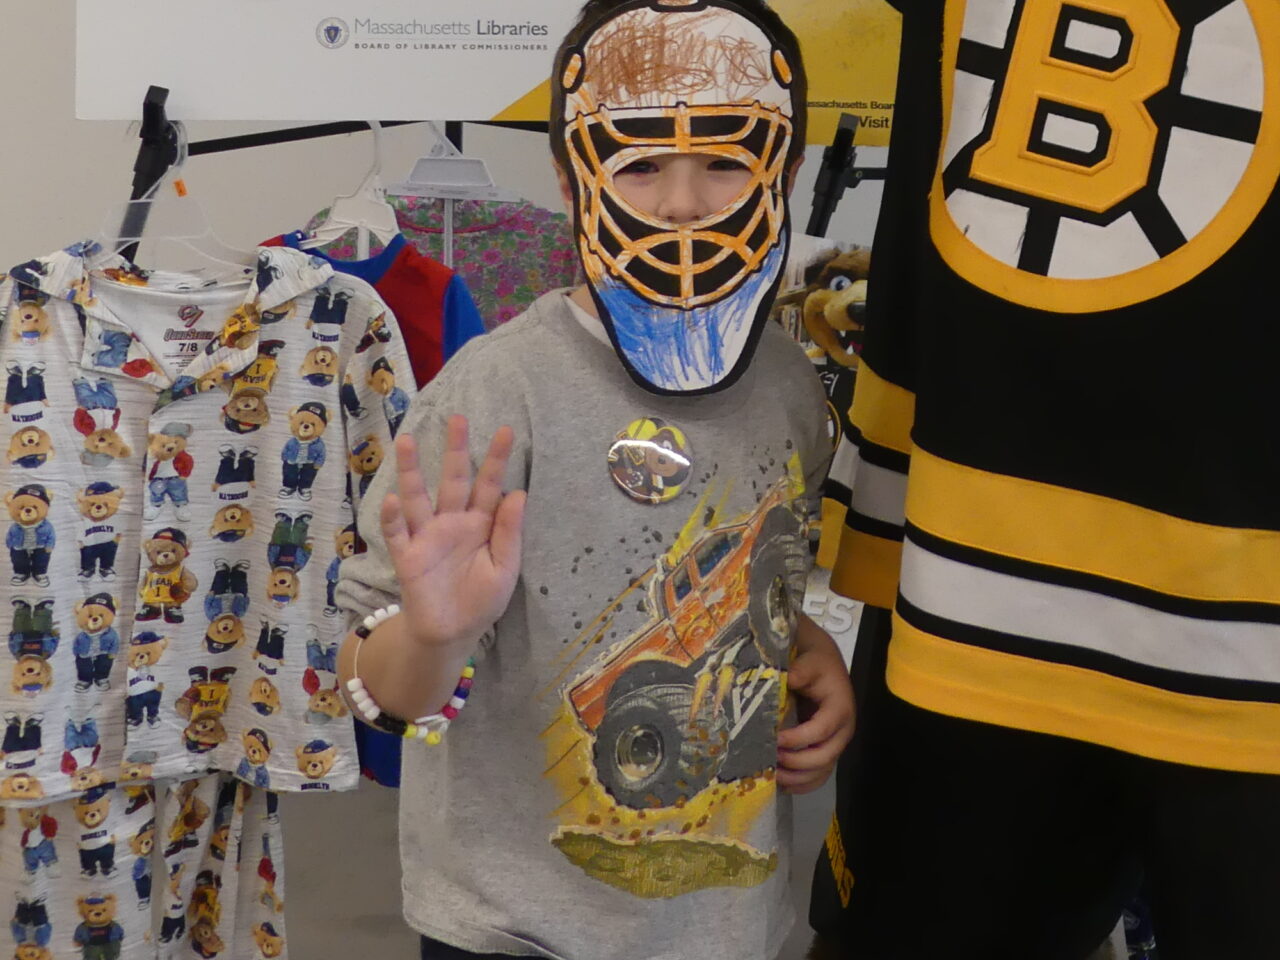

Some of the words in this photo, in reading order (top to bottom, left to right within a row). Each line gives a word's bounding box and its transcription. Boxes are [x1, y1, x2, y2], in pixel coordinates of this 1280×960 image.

[354, 18, 471, 35] Massachusetts
[476, 19, 549, 36] Libraries
[462, 43, 549, 51] COMMISSIONERS
[870, 101, 894, 110] Boar
[859, 116, 890, 128] Visit
[178, 343, 198, 353] 7/8
